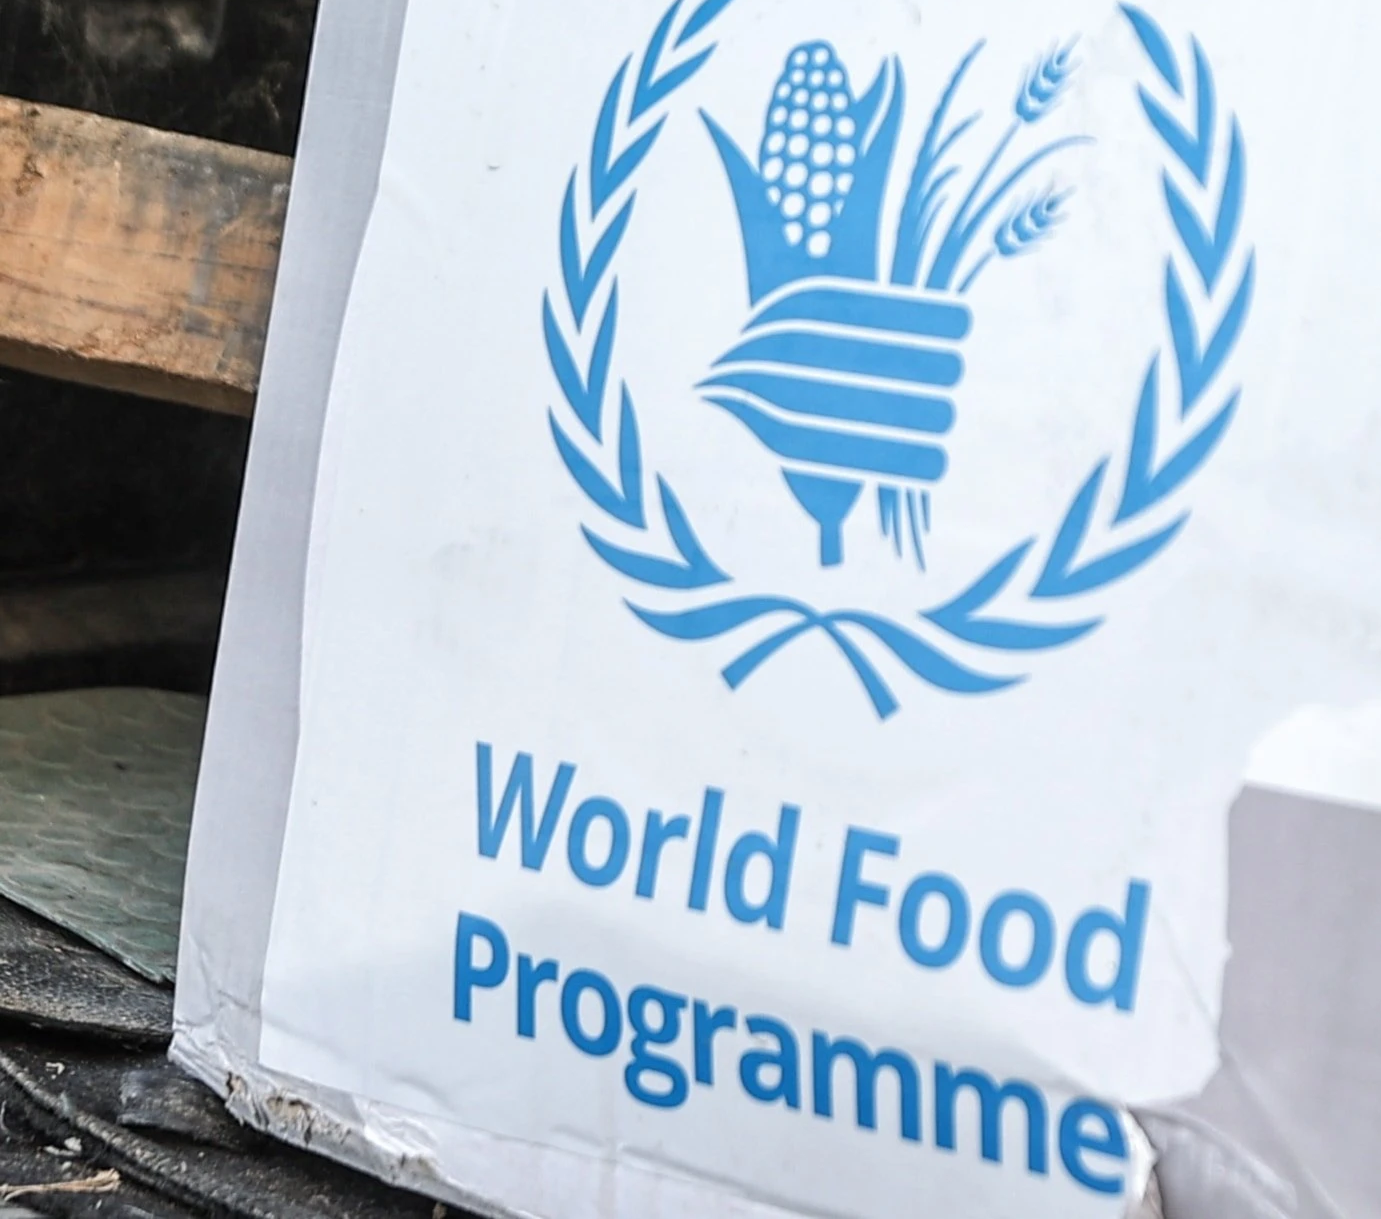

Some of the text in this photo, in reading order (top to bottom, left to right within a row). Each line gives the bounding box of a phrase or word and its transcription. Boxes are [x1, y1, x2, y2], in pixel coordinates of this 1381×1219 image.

[476, 741, 1151, 1013] World Food
[453, 911, 1130, 1197] Programme
